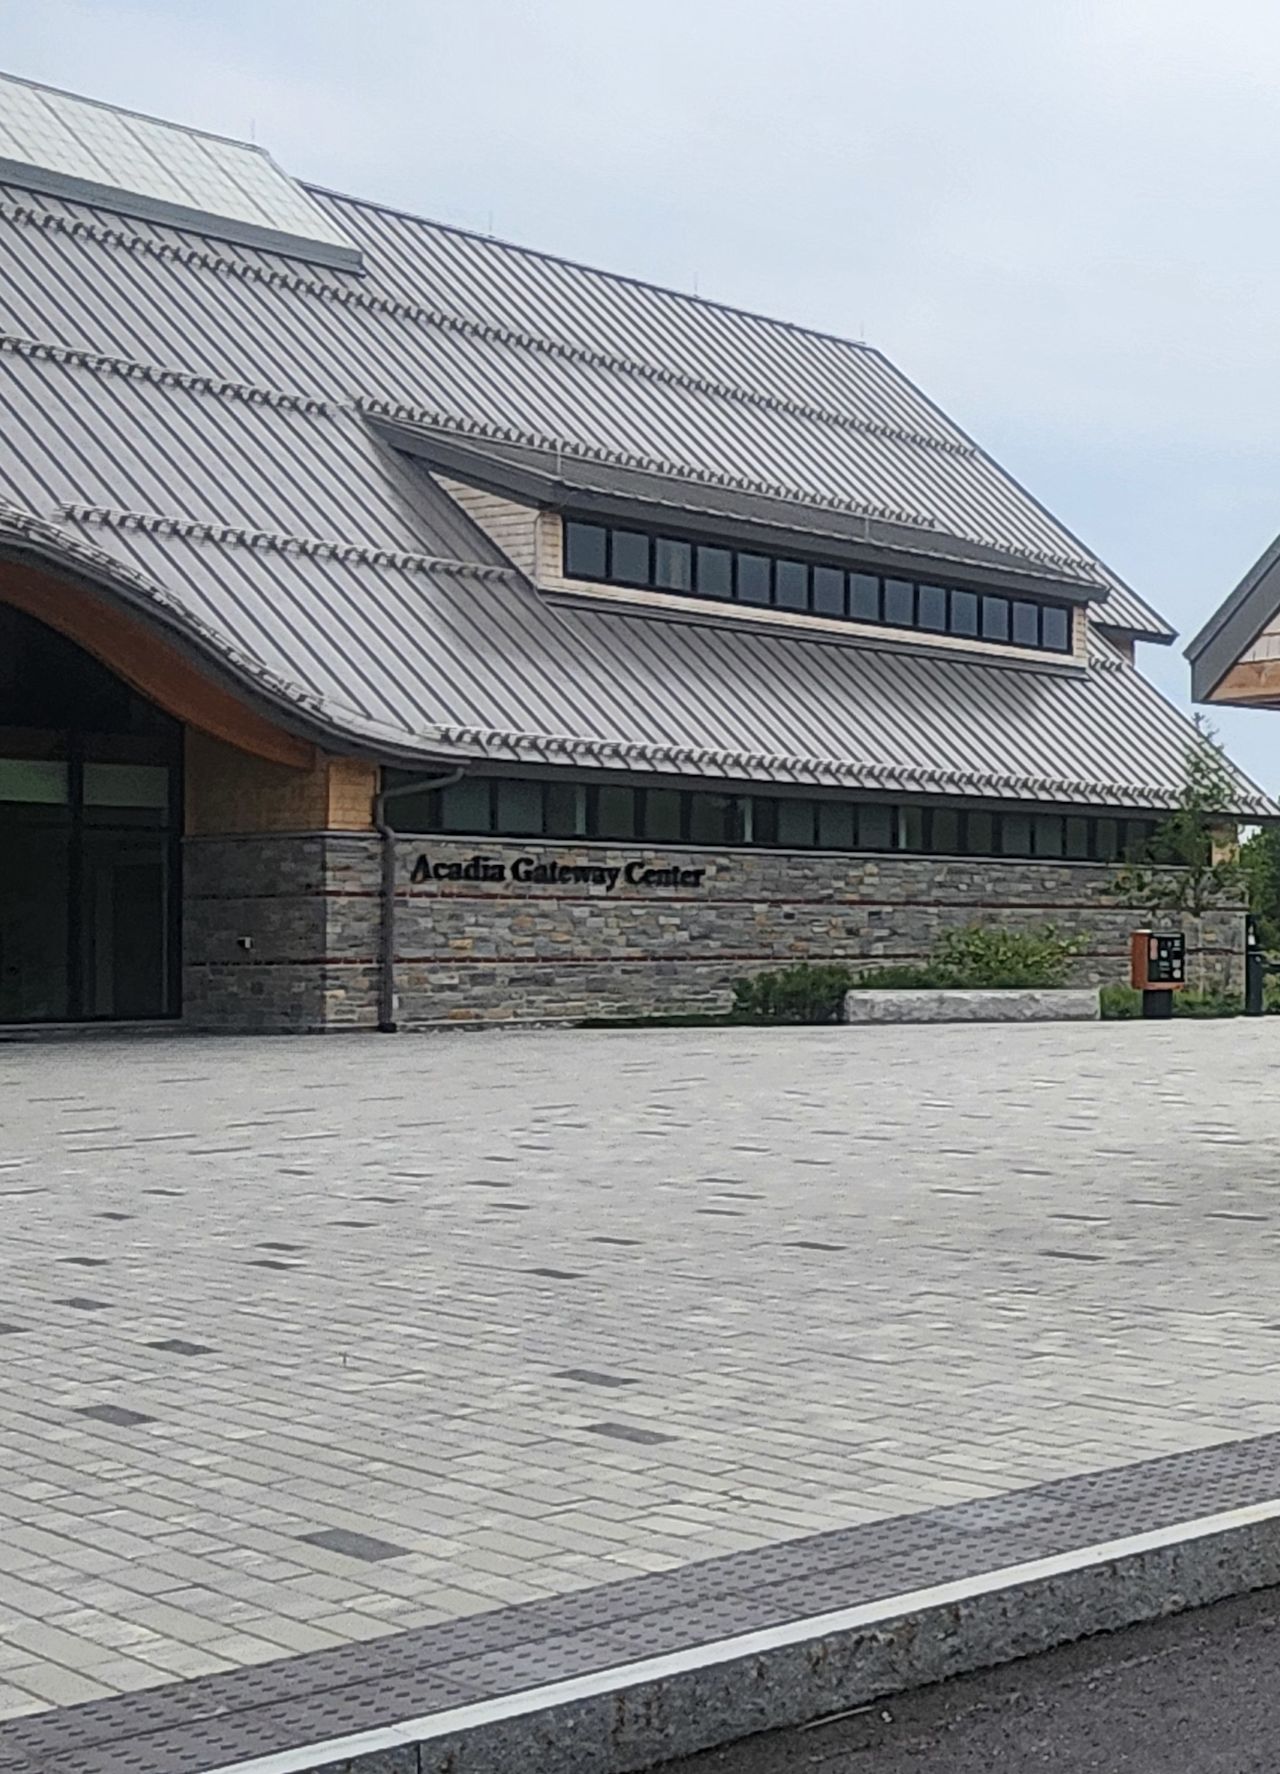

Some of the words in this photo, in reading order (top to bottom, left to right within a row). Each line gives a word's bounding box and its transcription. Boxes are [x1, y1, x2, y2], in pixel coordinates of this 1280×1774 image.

[409, 853, 506, 884] Acadia
[510, 857, 622, 892] Gateway
[624, 861, 706, 888] Center
